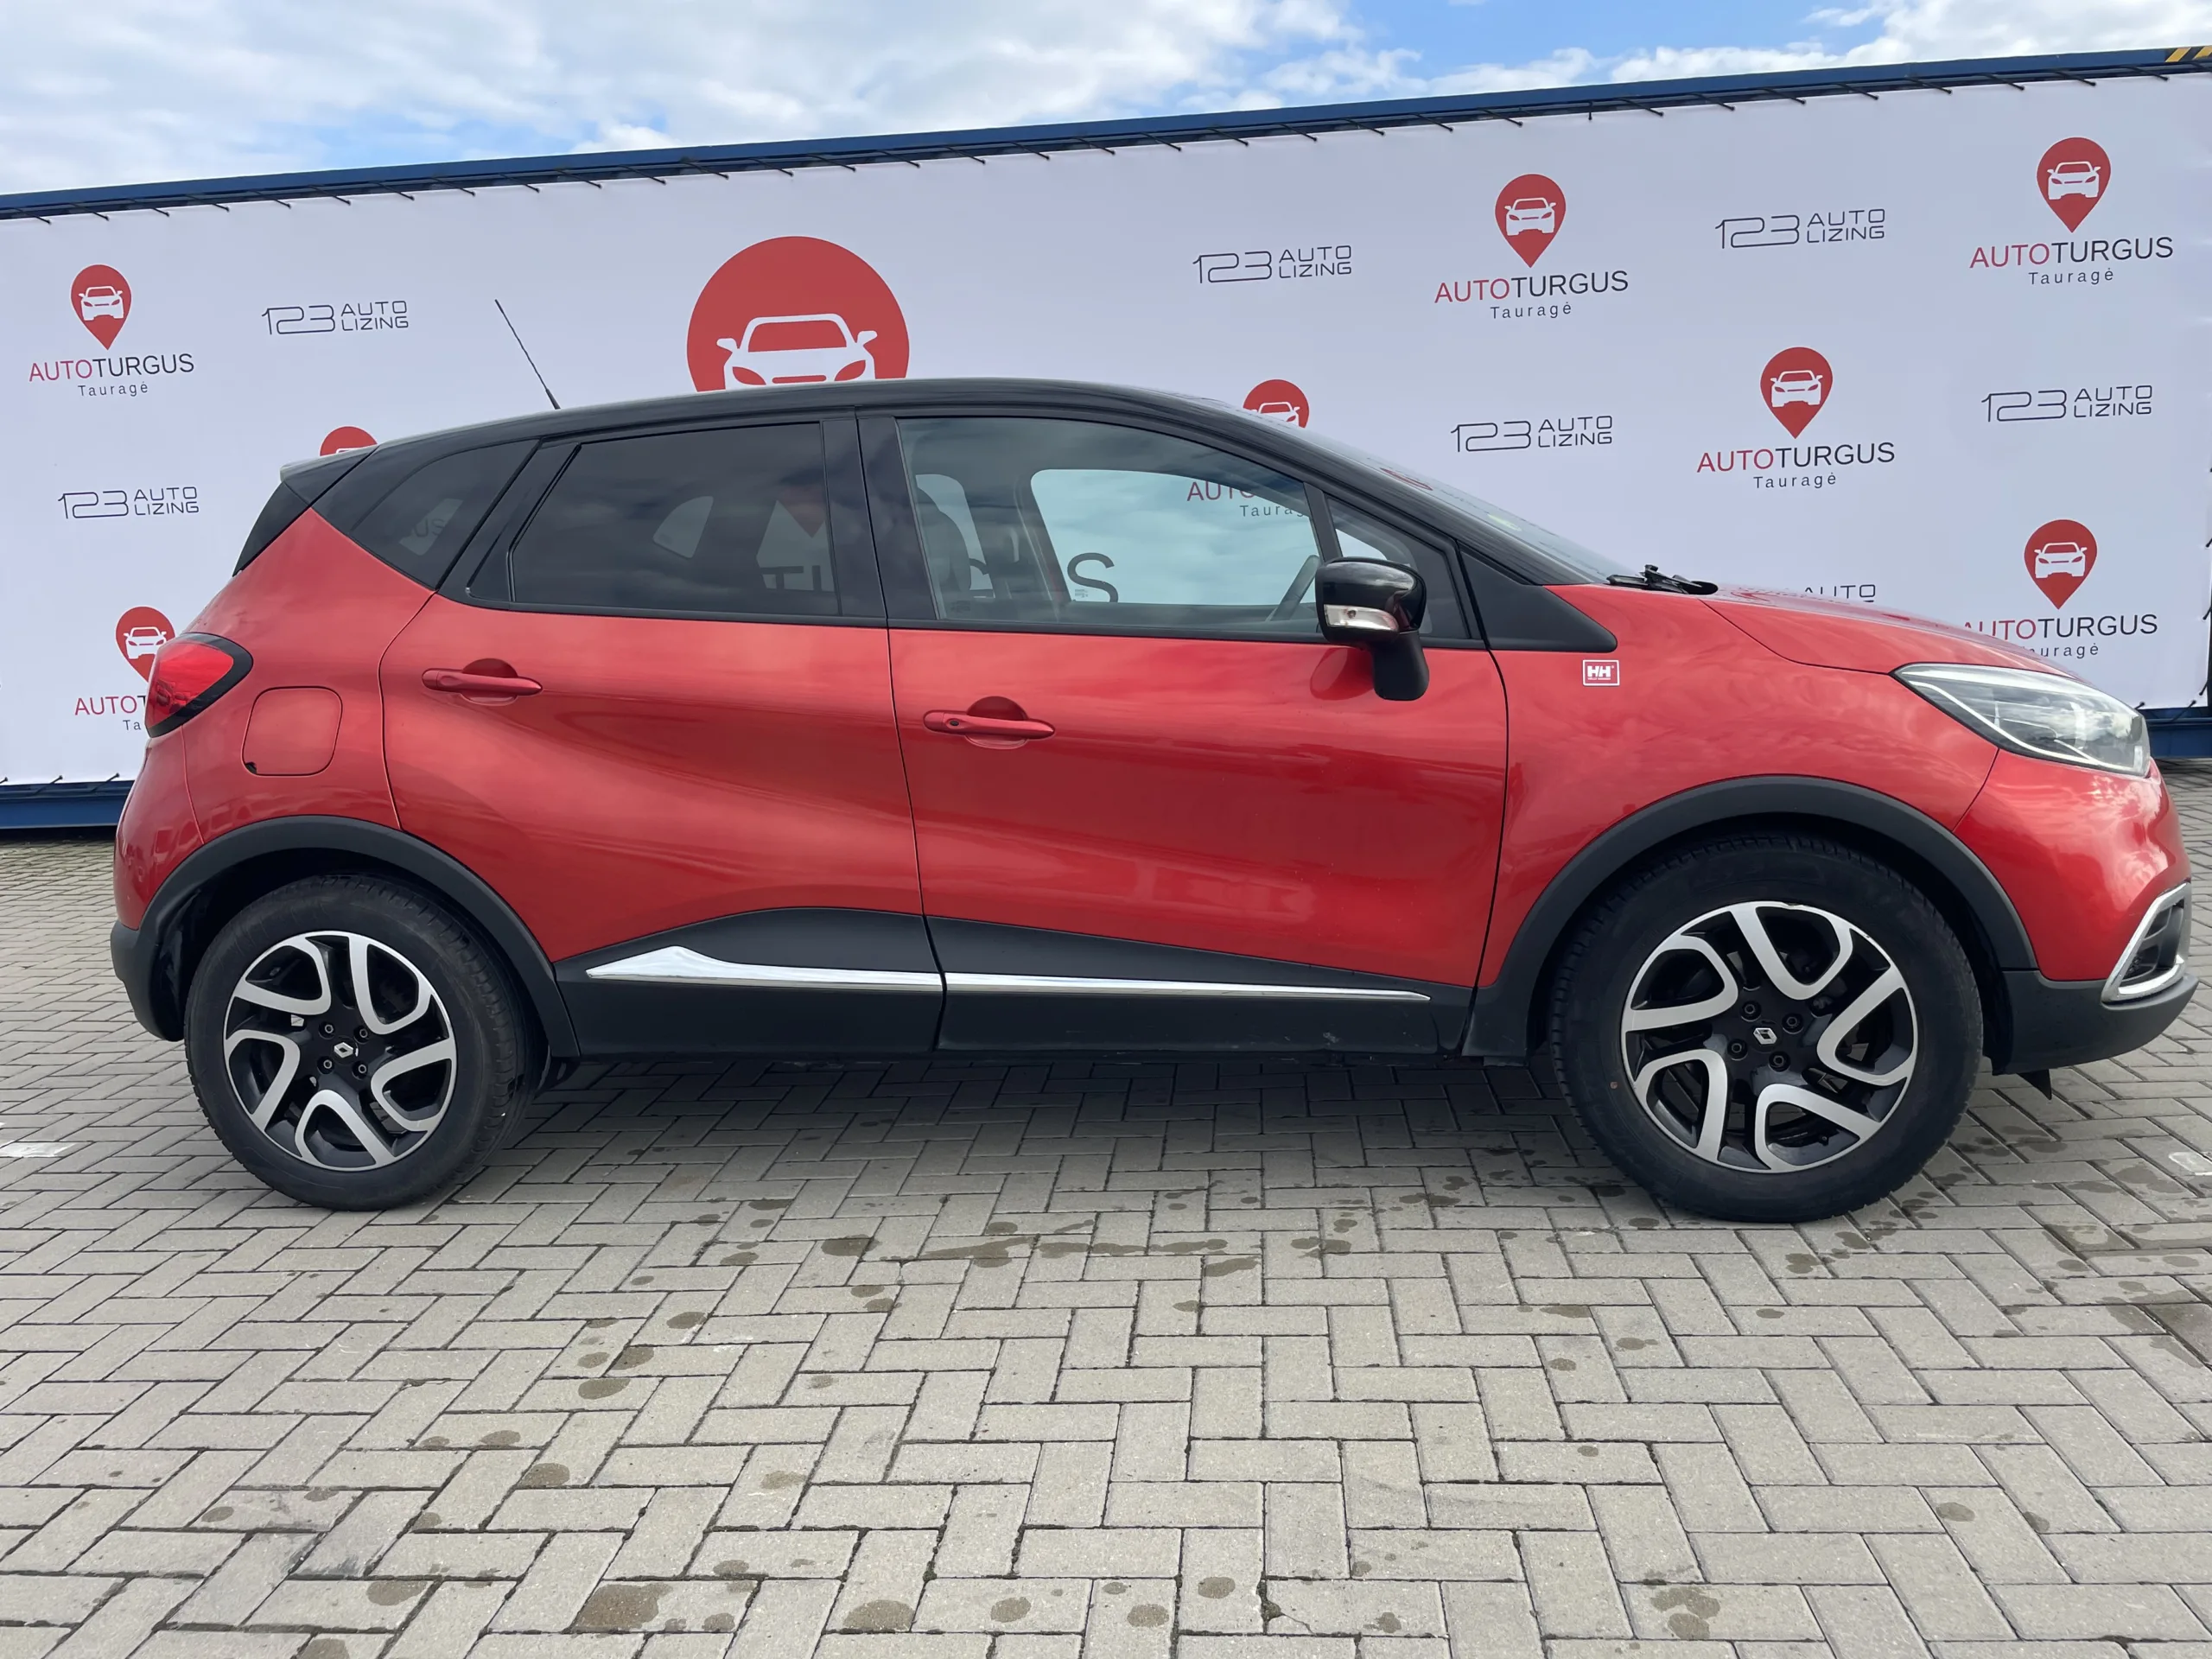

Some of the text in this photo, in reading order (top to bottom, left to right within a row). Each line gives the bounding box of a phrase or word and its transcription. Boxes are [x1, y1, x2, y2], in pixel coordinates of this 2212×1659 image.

[1807, 208, 1885, 228] AUTO
[1714, 214, 1801, 249] 123
[1807, 225, 1885, 244] LIZING
[1278, 245, 1352, 263] AUTO
[1969, 236, 2174, 269] AUTOTURGUS
[1192, 251, 1273, 284] 123
[1278, 260, 1352, 279] LIZING
[2028, 267, 2113, 286] Tauragė
[1433, 270, 1629, 304] AUTOTURGUS
[340, 300, 408, 318] AUTO
[1490, 302, 1572, 320] Tauragė
[261, 304, 336, 335] 123
[340, 315, 410, 332] LIZING
[29, 353, 194, 382] AUTOTURGUS
[77, 381, 148, 397] Tauragė
[2074, 385, 2152, 403] AUTO
[1980, 389, 2068, 423] 123
[2074, 400, 2152, 418] LIZING
[1537, 415, 1613, 434] AUTO
[1450, 420, 1532, 453] 123
[1537, 430, 1612, 448] LIZING
[1696, 442, 1895, 474] AUTOTURGUS
[1752, 472, 1836, 489] Tauragė
[133, 486, 198, 502] AUTO
[57, 490, 130, 519] 123
[133, 499, 200, 516] LIZING
